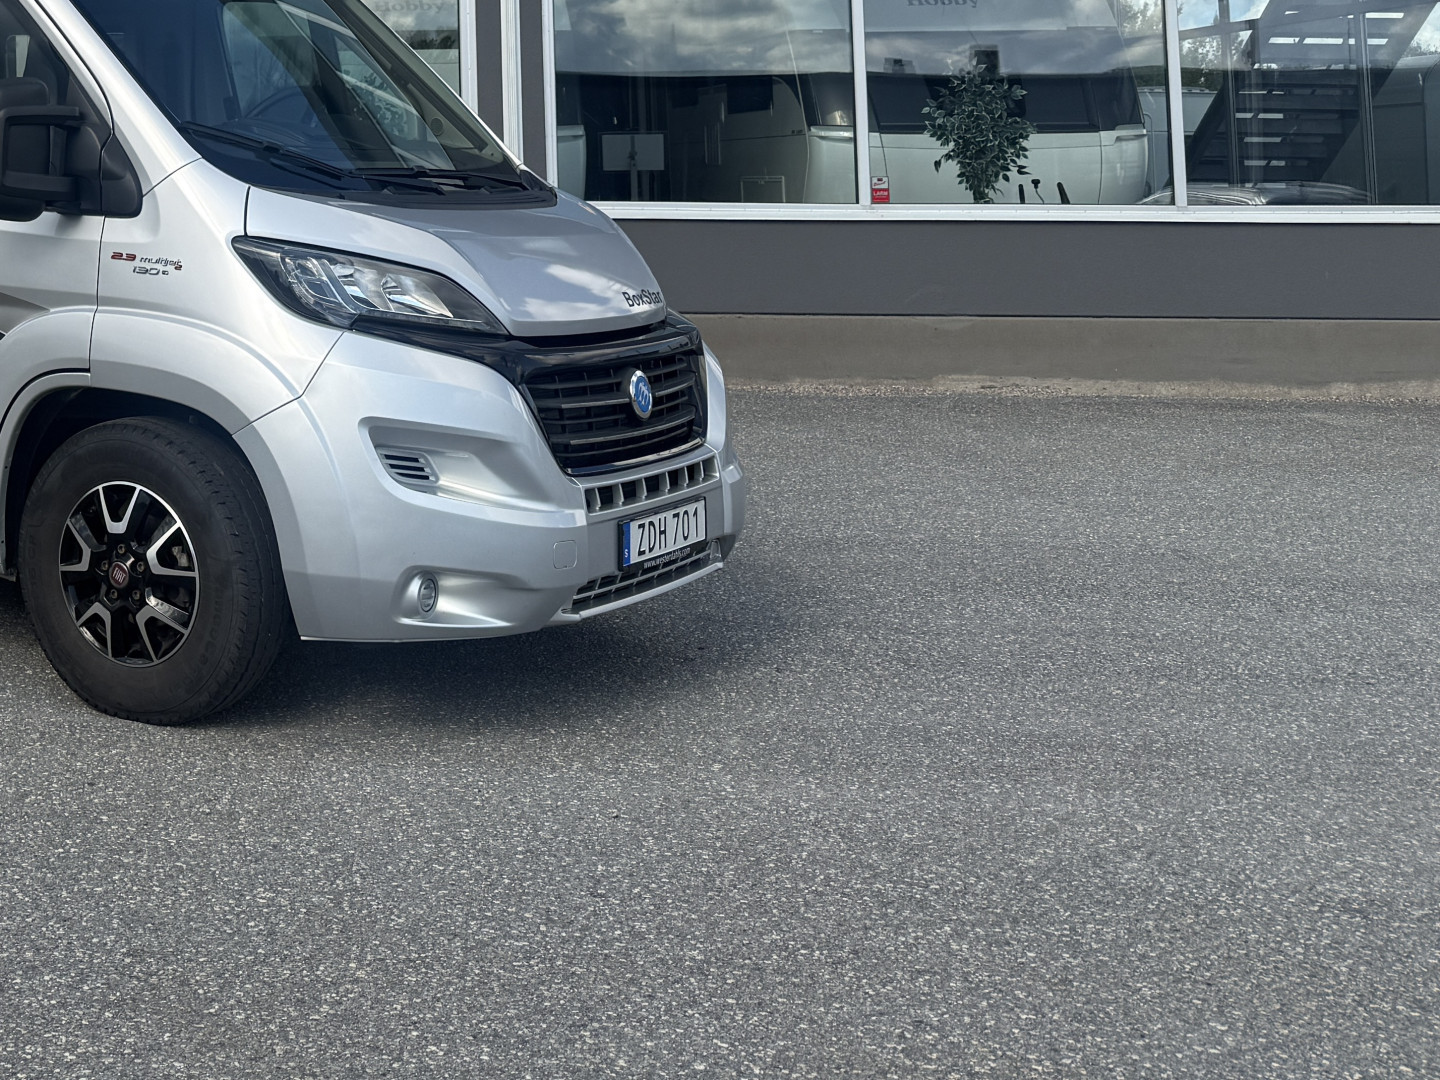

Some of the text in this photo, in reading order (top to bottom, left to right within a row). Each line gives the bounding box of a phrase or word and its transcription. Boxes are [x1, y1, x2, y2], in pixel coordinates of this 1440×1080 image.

[132, 266, 161, 276] 130
[621, 289, 663, 308] BoxStar
[637, 505, 699, 557] ZDH 701
[624, 549, 629, 558] S
[643, 547, 691, 569] www.westerdahls.com
[112, 566, 126, 584] FIAT
